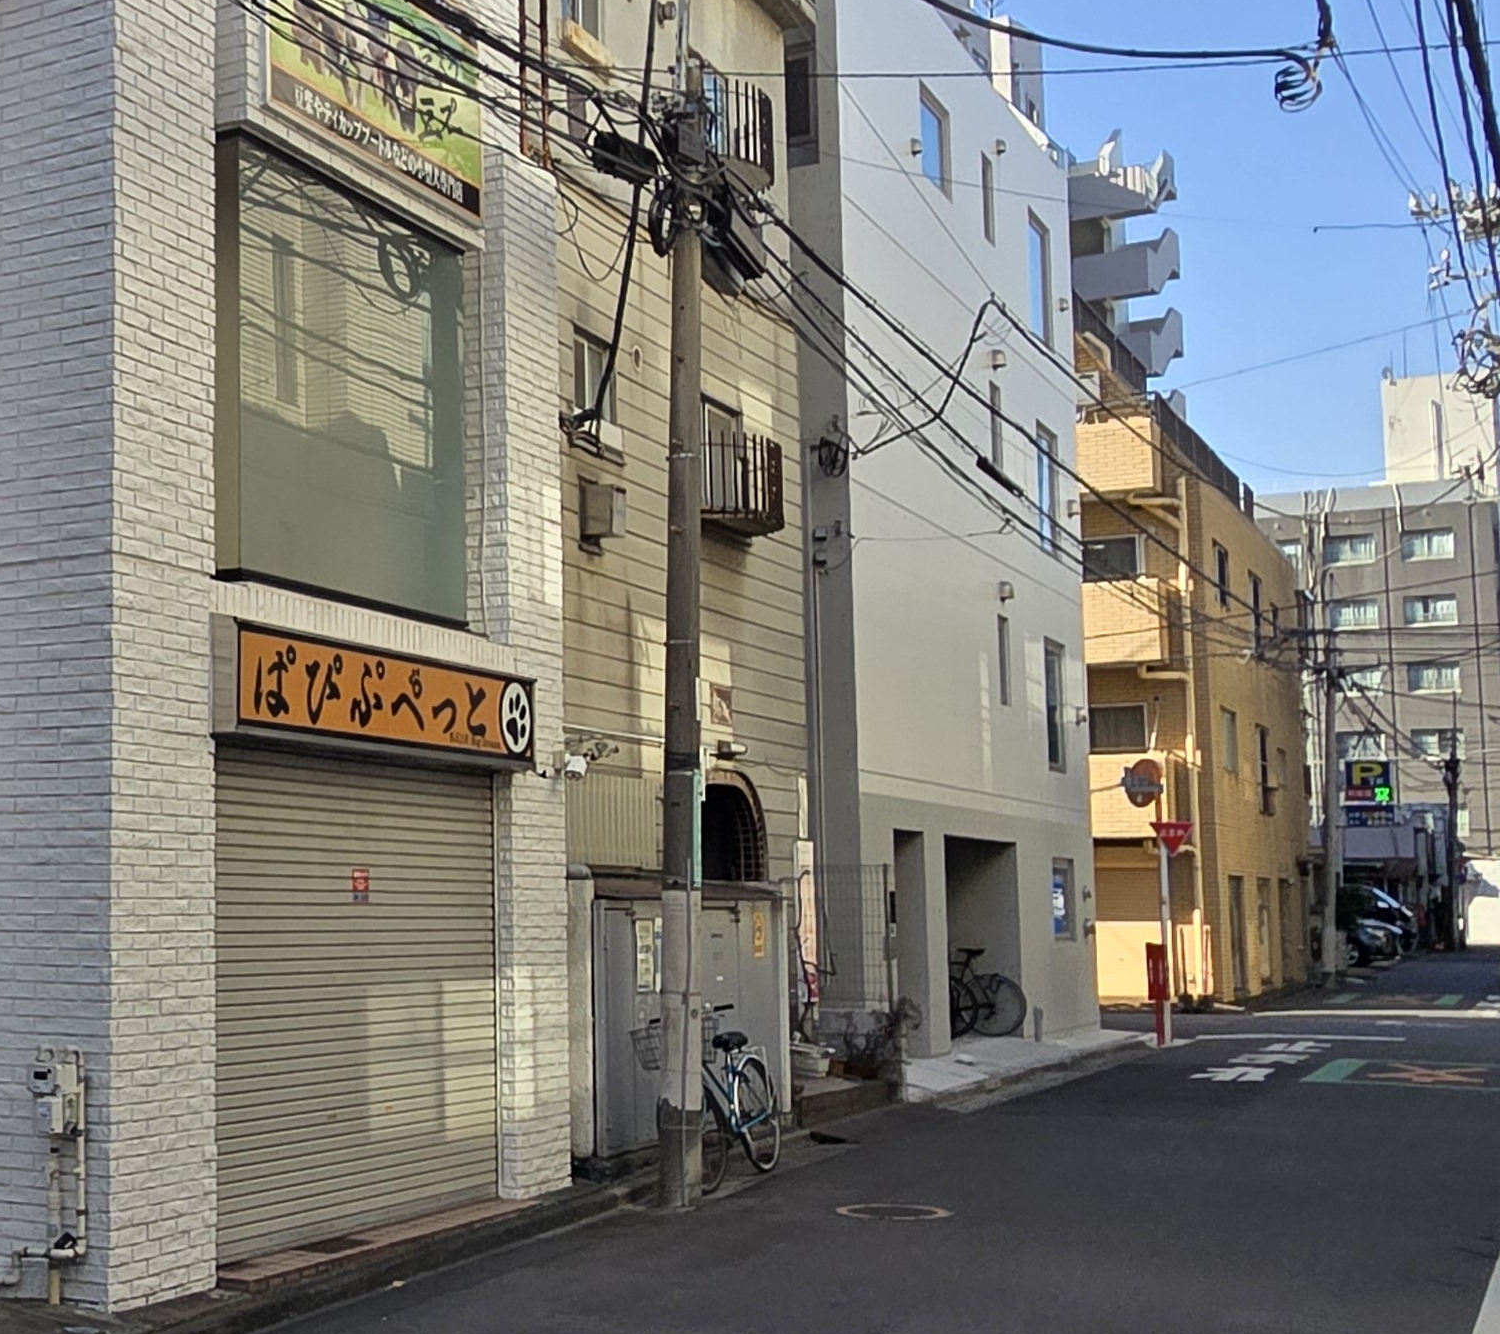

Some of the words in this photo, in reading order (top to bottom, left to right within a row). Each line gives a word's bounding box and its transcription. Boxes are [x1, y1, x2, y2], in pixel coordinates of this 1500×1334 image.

[254, 644, 488, 738] ぱぴぷぺっと
[1352, 763, 1383, 785] P
